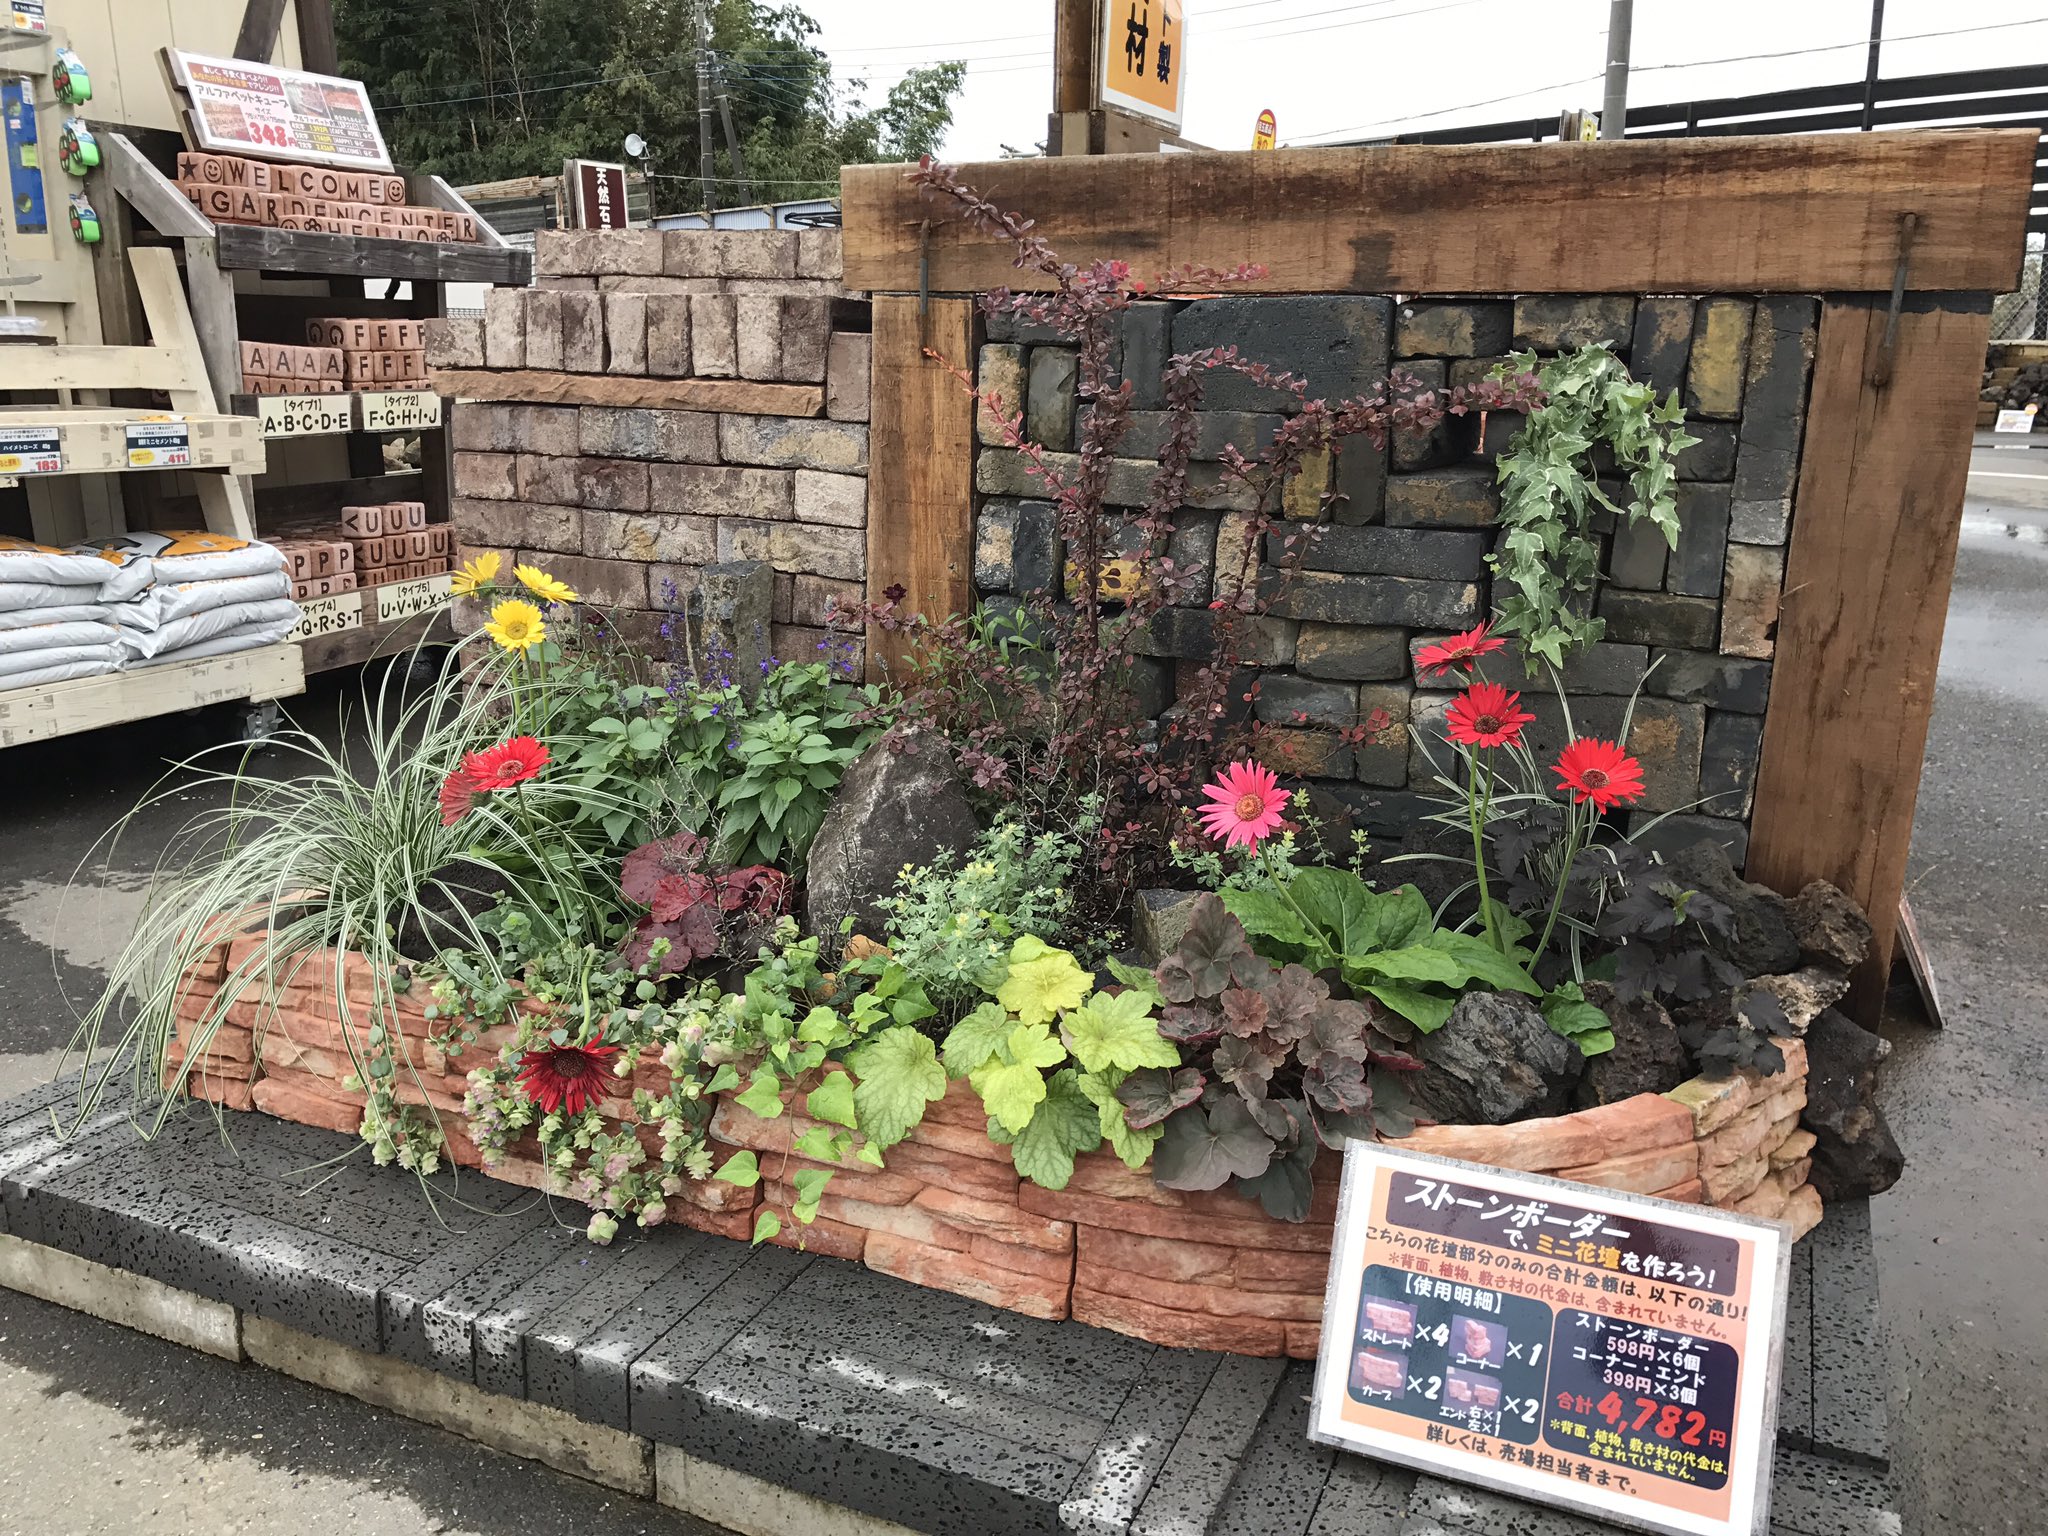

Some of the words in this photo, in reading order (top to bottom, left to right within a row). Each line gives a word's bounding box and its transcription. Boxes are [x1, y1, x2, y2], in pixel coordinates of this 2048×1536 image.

[228, 162, 380, 200] WELCOME
[36, 460, 58, 471] 183
[1404, 1178, 1631, 1240] ストーンボーダー
[1404, 1273, 1503, 1315] 【使用明細】
[1362, 1328, 1412, 1350] ストレート
[1575, 1312, 1710, 1352] ストーンボーダー
[1455, 1352, 1501, 1371] コーナー
[1588, 1442, 1697, 1482] 含まれていません。
